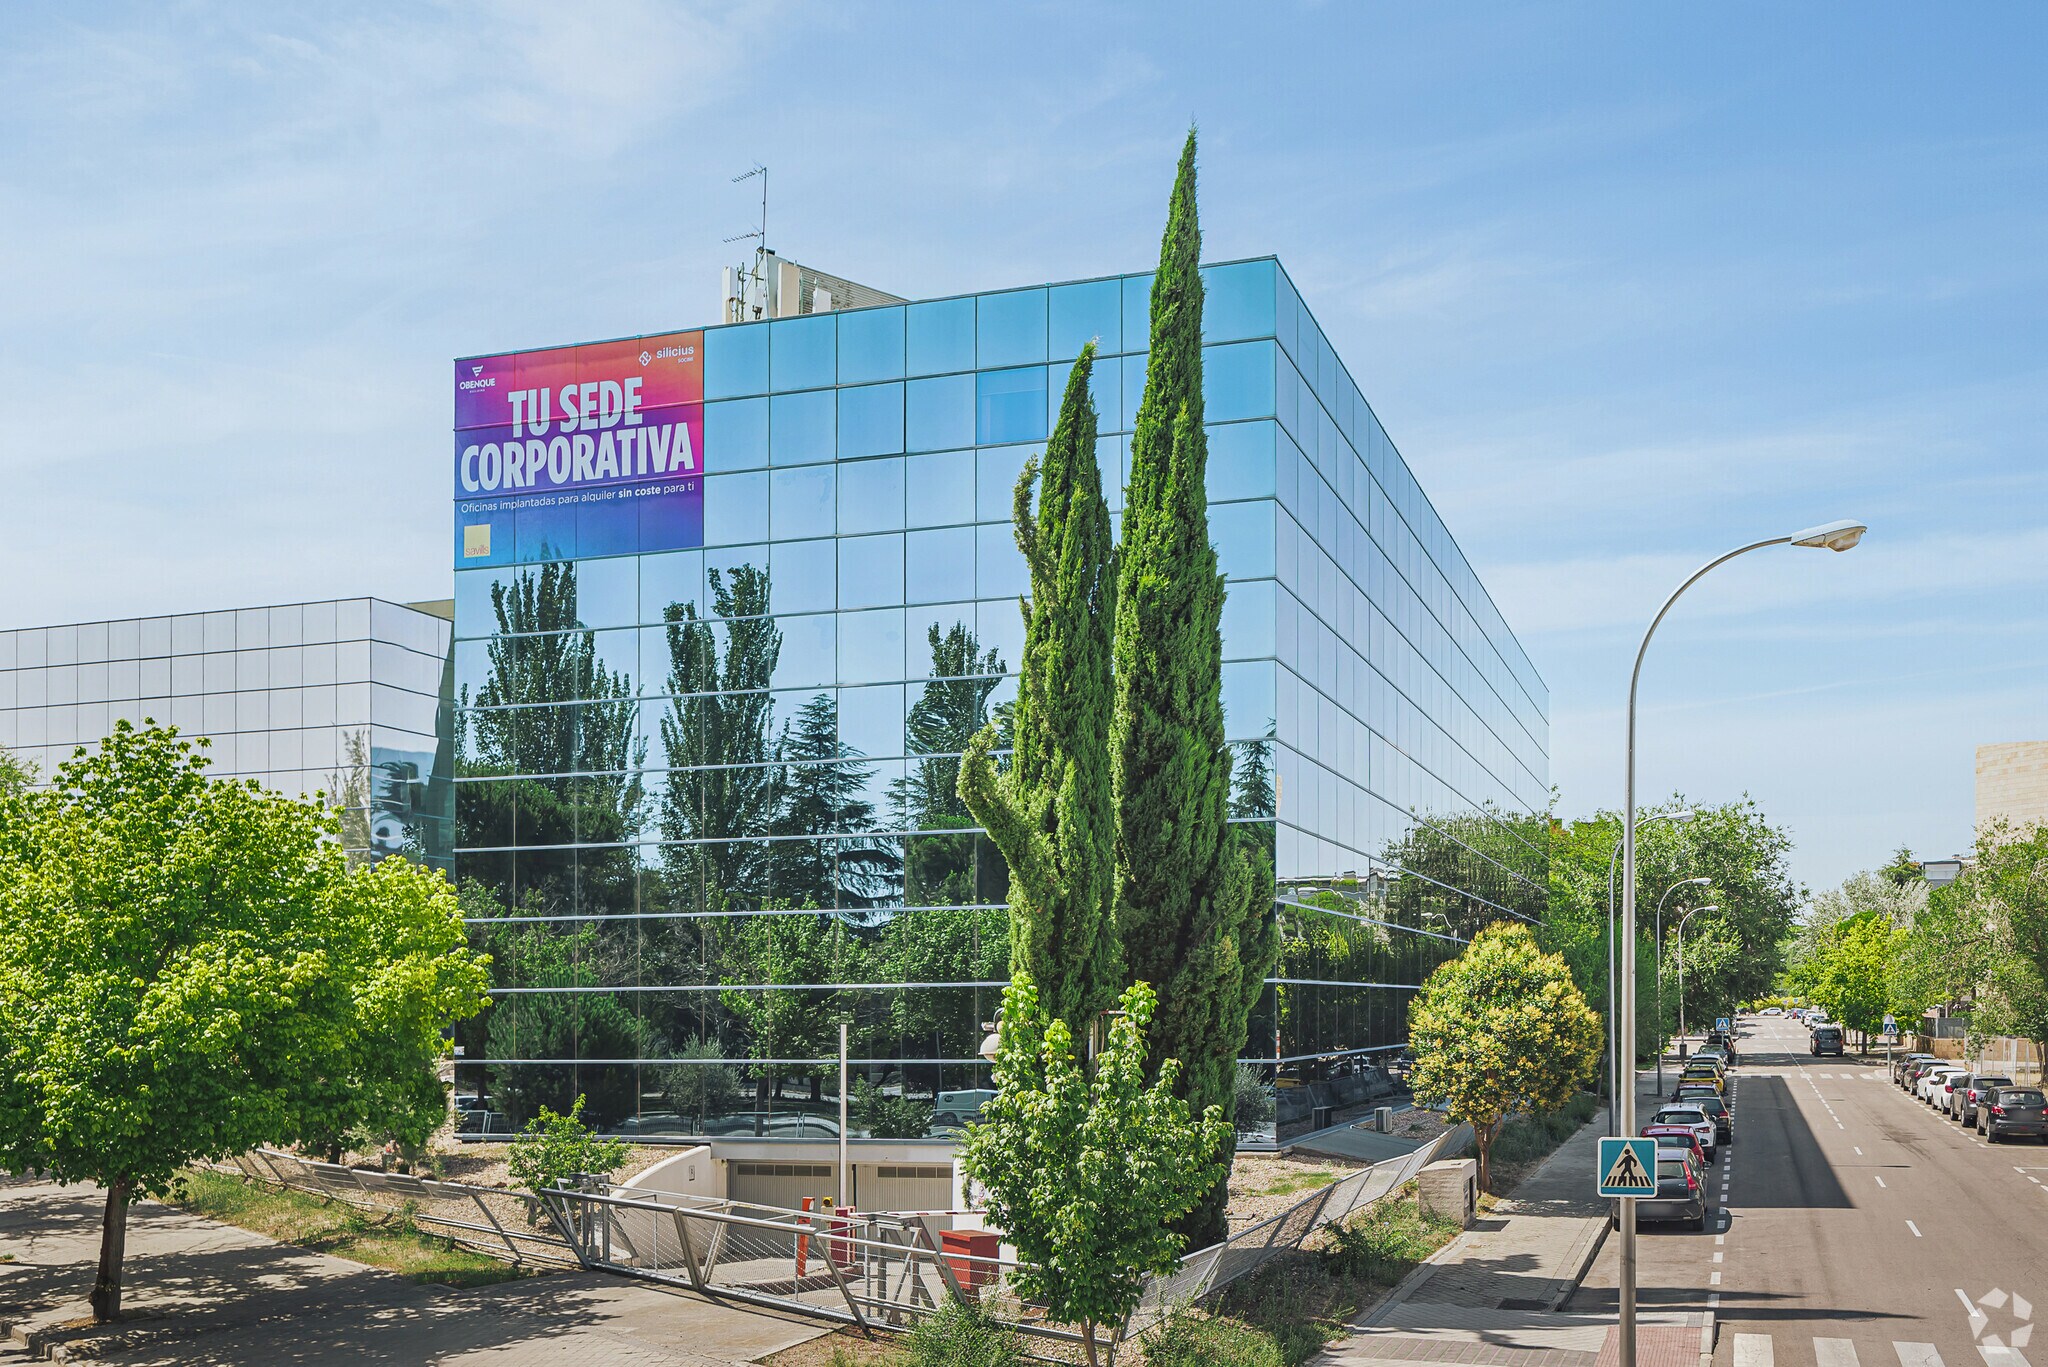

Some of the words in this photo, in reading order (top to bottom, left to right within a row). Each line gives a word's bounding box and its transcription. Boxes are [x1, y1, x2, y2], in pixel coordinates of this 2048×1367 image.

[656, 345, 695, 359] silicius
[459, 377, 496, 390] OBENQUE
[507, 387, 550, 438] TU
[559, 376, 643, 433] SEDE
[460, 422, 695, 492] CORPORATIVA
[461, 502, 498, 513] Oficinas
[500, 497, 556, 510] implantadas
[558, 495, 579, 506] para
[581, 490, 616, 502] alquiler
[618, 488, 632, 498] sin
[634, 486, 661, 496] coste
[663, 484, 685, 495] para
[687, 481, 694, 491] ti
[465, 544, 489, 556] savills
